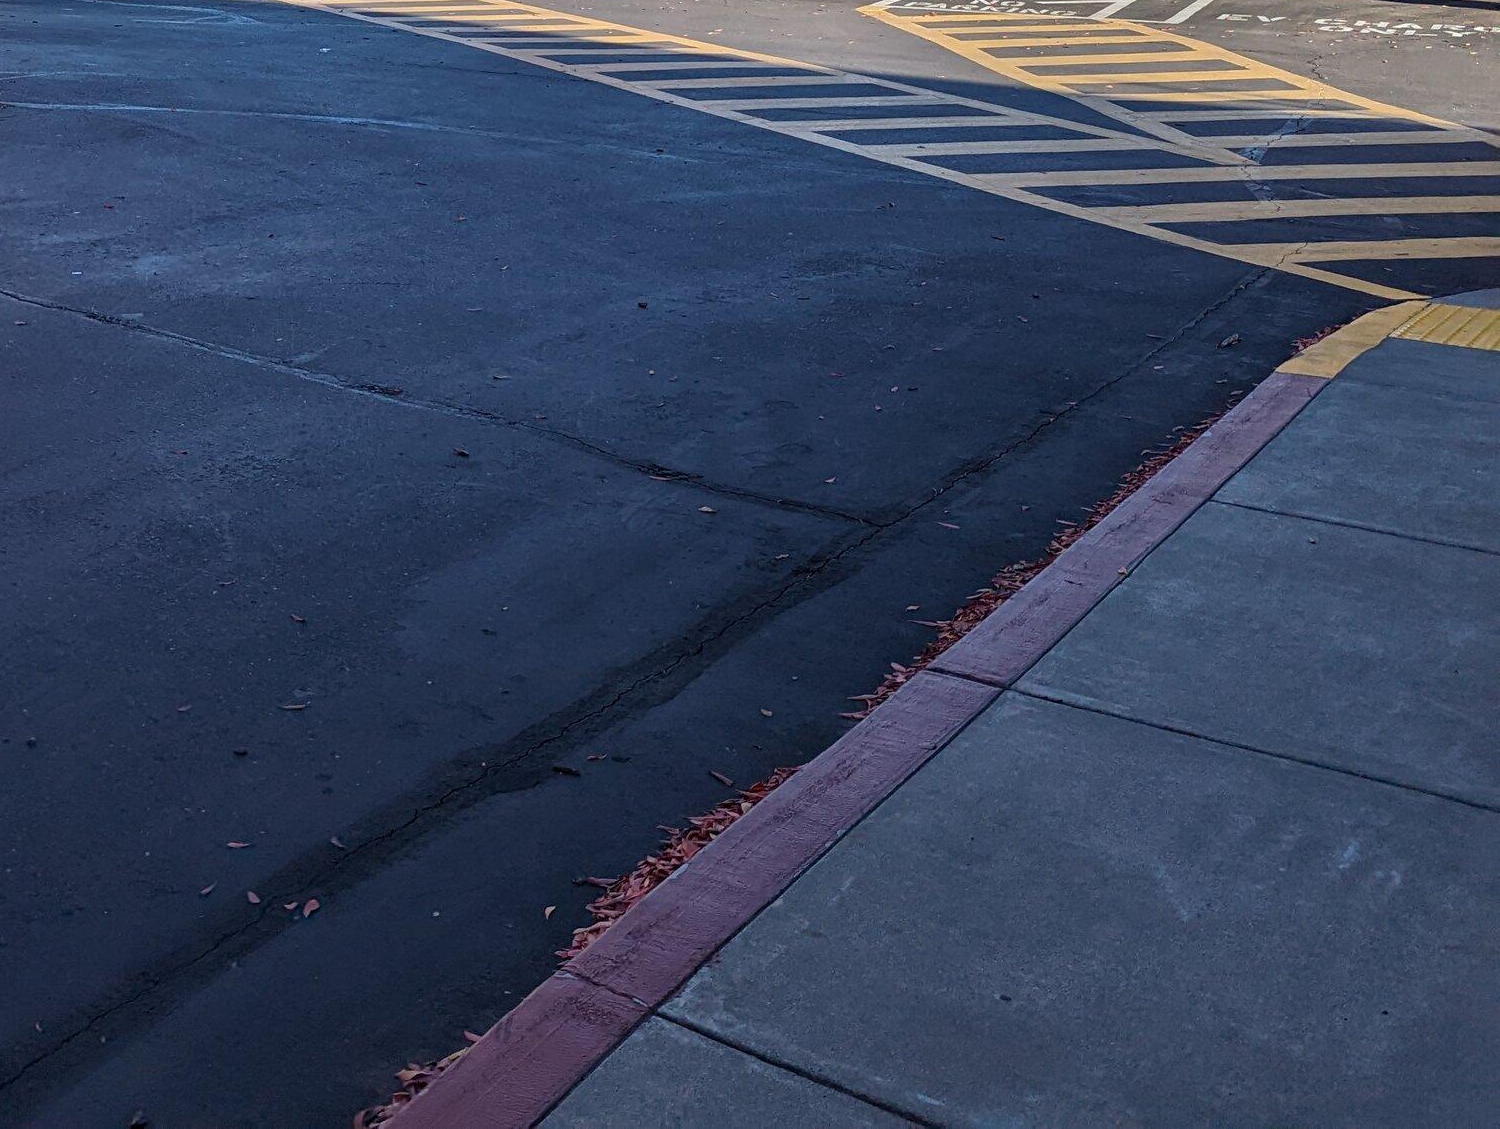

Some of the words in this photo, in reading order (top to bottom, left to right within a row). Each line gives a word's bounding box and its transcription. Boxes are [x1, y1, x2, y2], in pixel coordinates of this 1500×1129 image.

[904, 1, 1078, 16] PARKING
[969, 0, 1027, 7] NO
[1215, 13, 1288, 22] EV
[1318, 25, 1479, 38] ONLY
